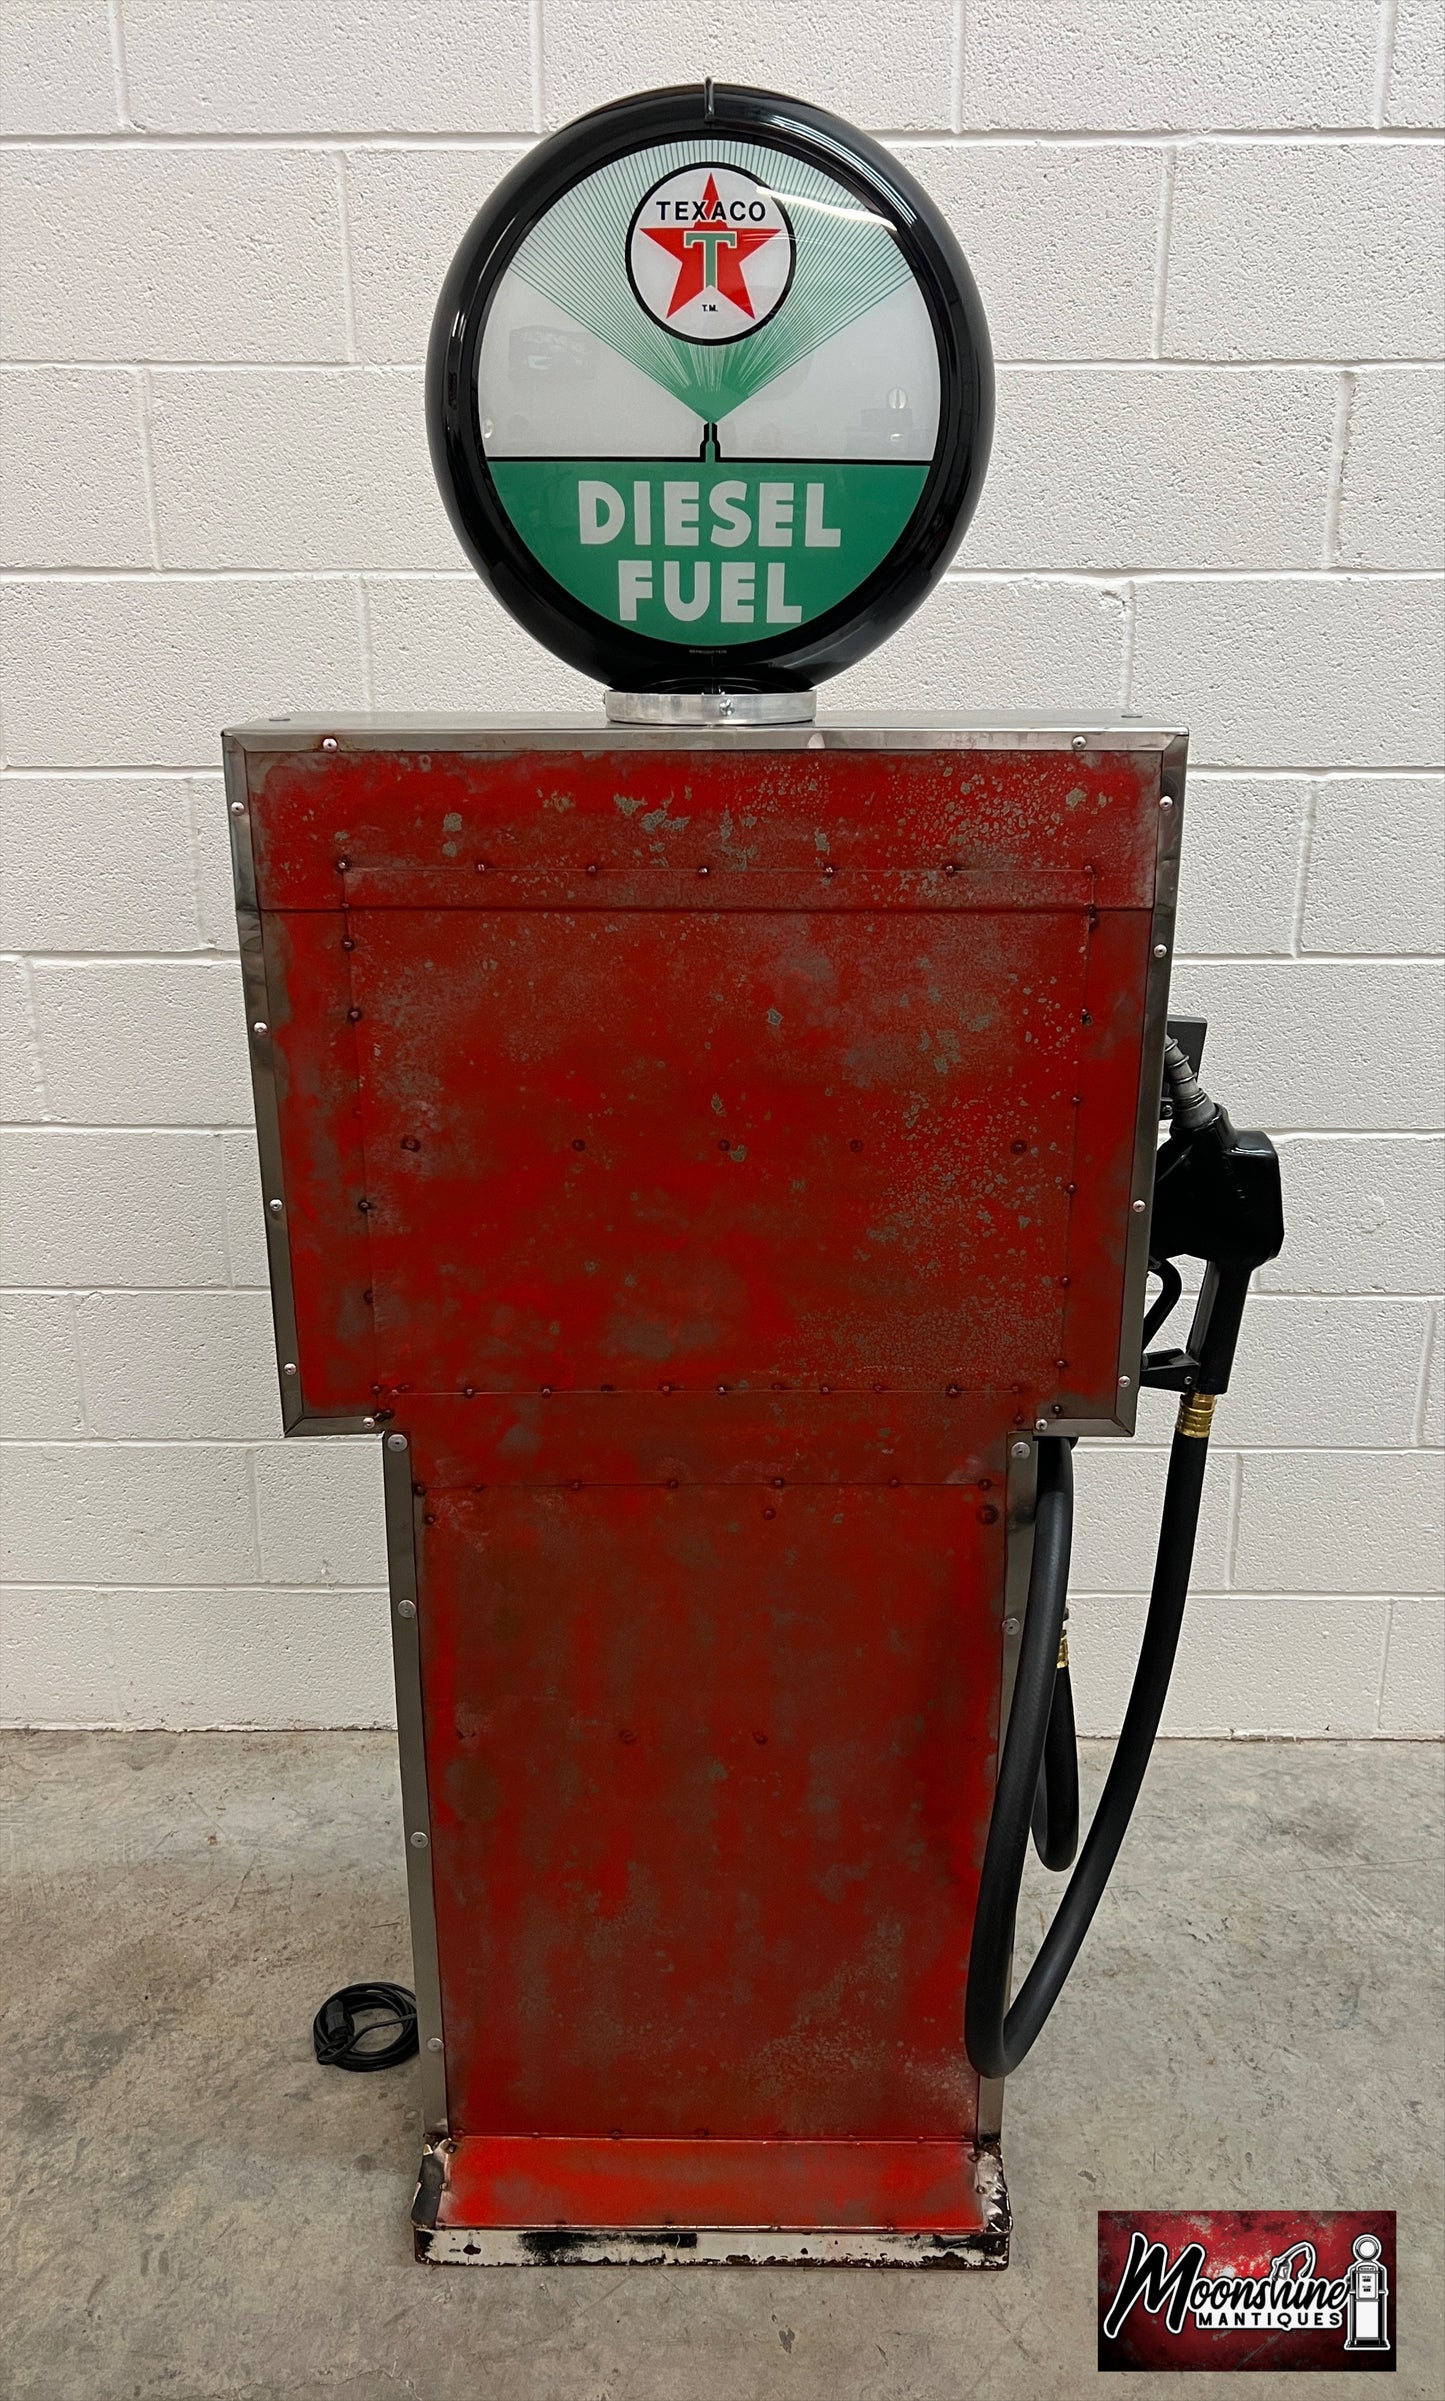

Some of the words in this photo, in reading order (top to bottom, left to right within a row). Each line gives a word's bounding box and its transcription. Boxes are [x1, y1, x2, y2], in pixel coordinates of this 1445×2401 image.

[656, 201, 766, 222] TEXACO
[684, 231, 737, 290] T
[578, 480, 841, 547] DIESEL
[618, 560, 802, 623] FUEL
